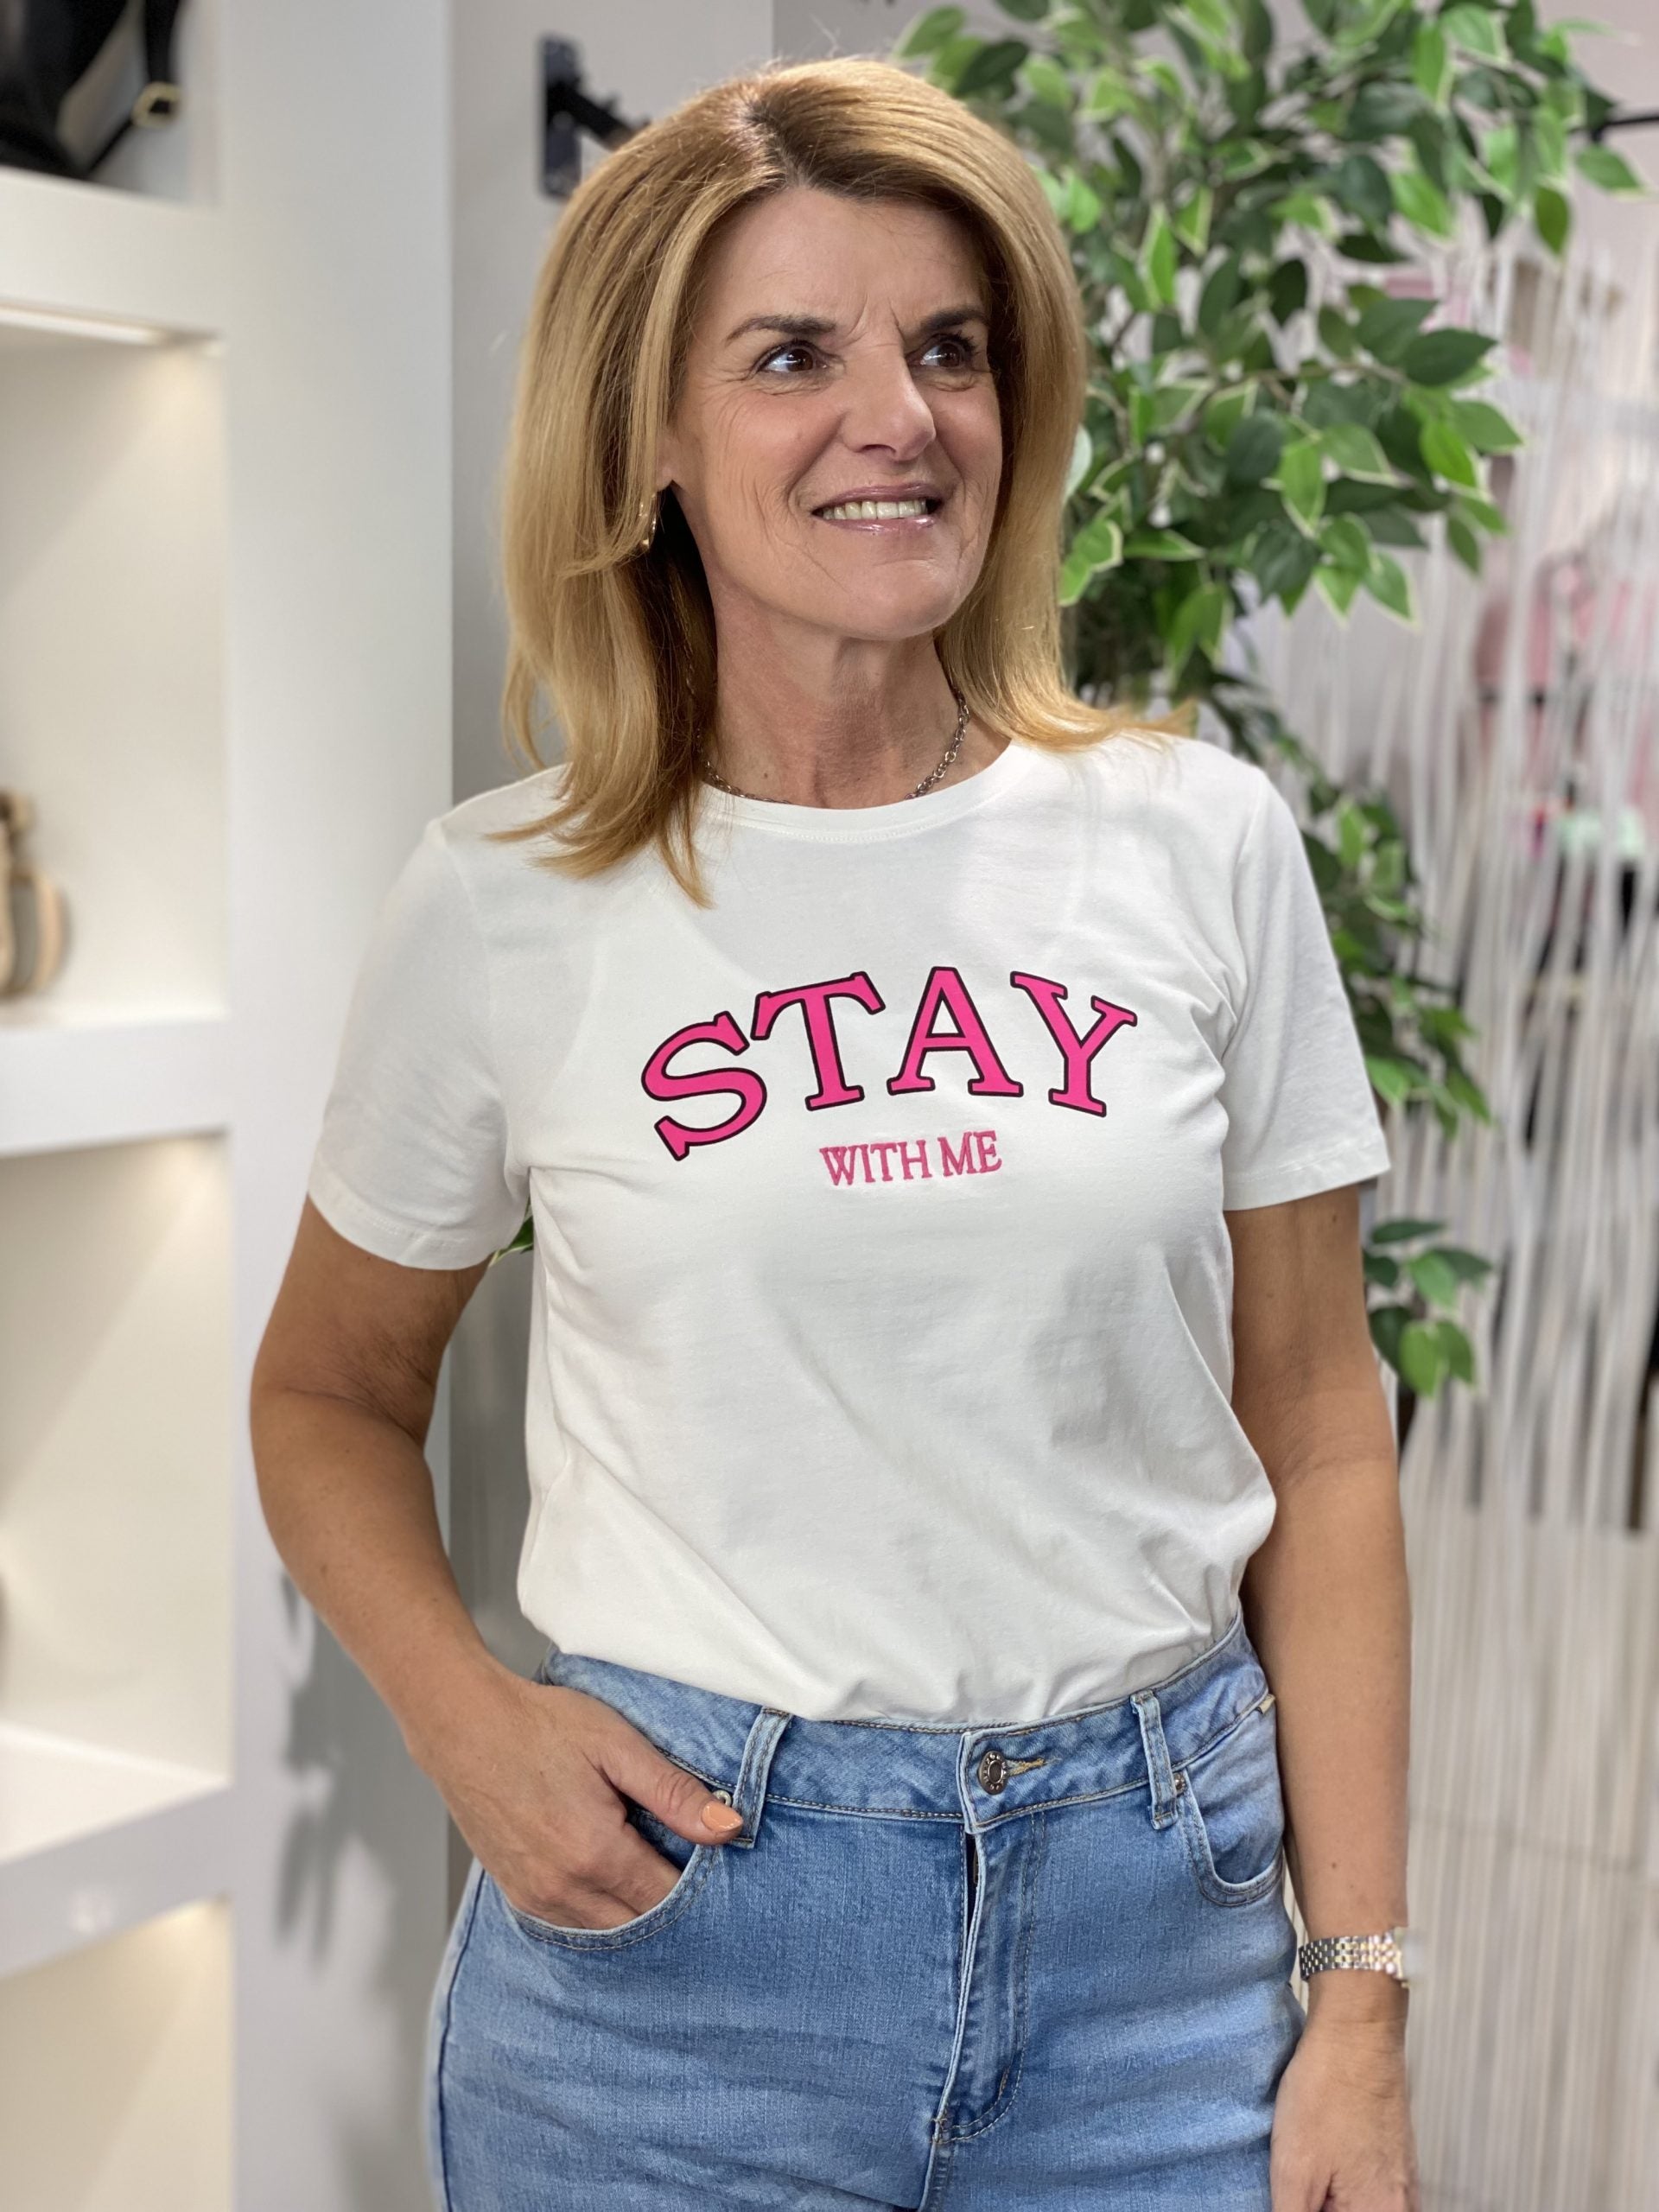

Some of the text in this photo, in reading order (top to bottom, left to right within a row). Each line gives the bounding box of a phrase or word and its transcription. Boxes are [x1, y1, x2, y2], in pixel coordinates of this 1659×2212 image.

[641, 966, 1138, 1161] STAY
[820, 1130, 1003, 1185] WITH ME
